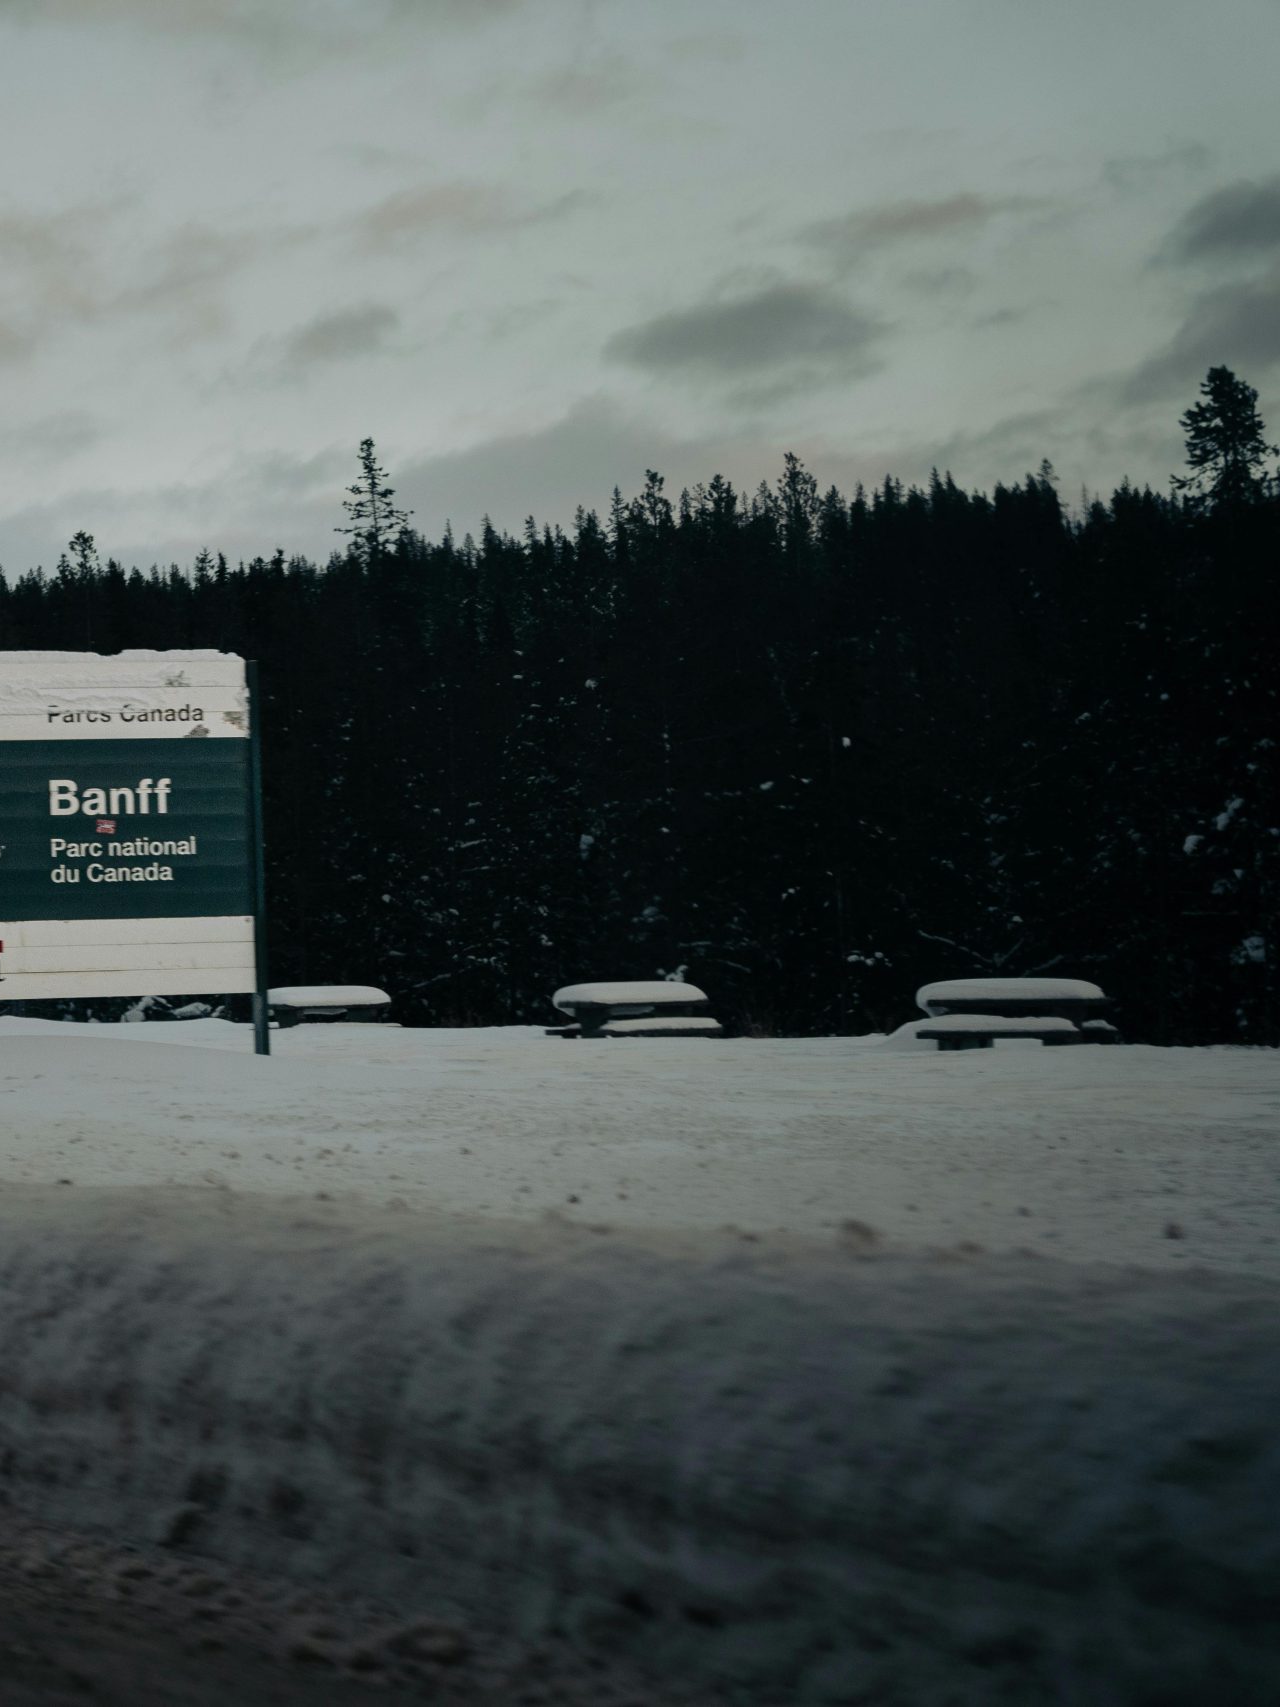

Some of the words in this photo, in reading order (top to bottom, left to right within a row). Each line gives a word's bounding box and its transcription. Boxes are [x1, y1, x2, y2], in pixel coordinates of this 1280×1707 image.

[48, 777, 172, 816] Banff
[50, 838, 102, 858] Parc
[108, 835, 197, 857] national
[51, 864, 79, 884] du
[87, 862, 174, 883] Canada
